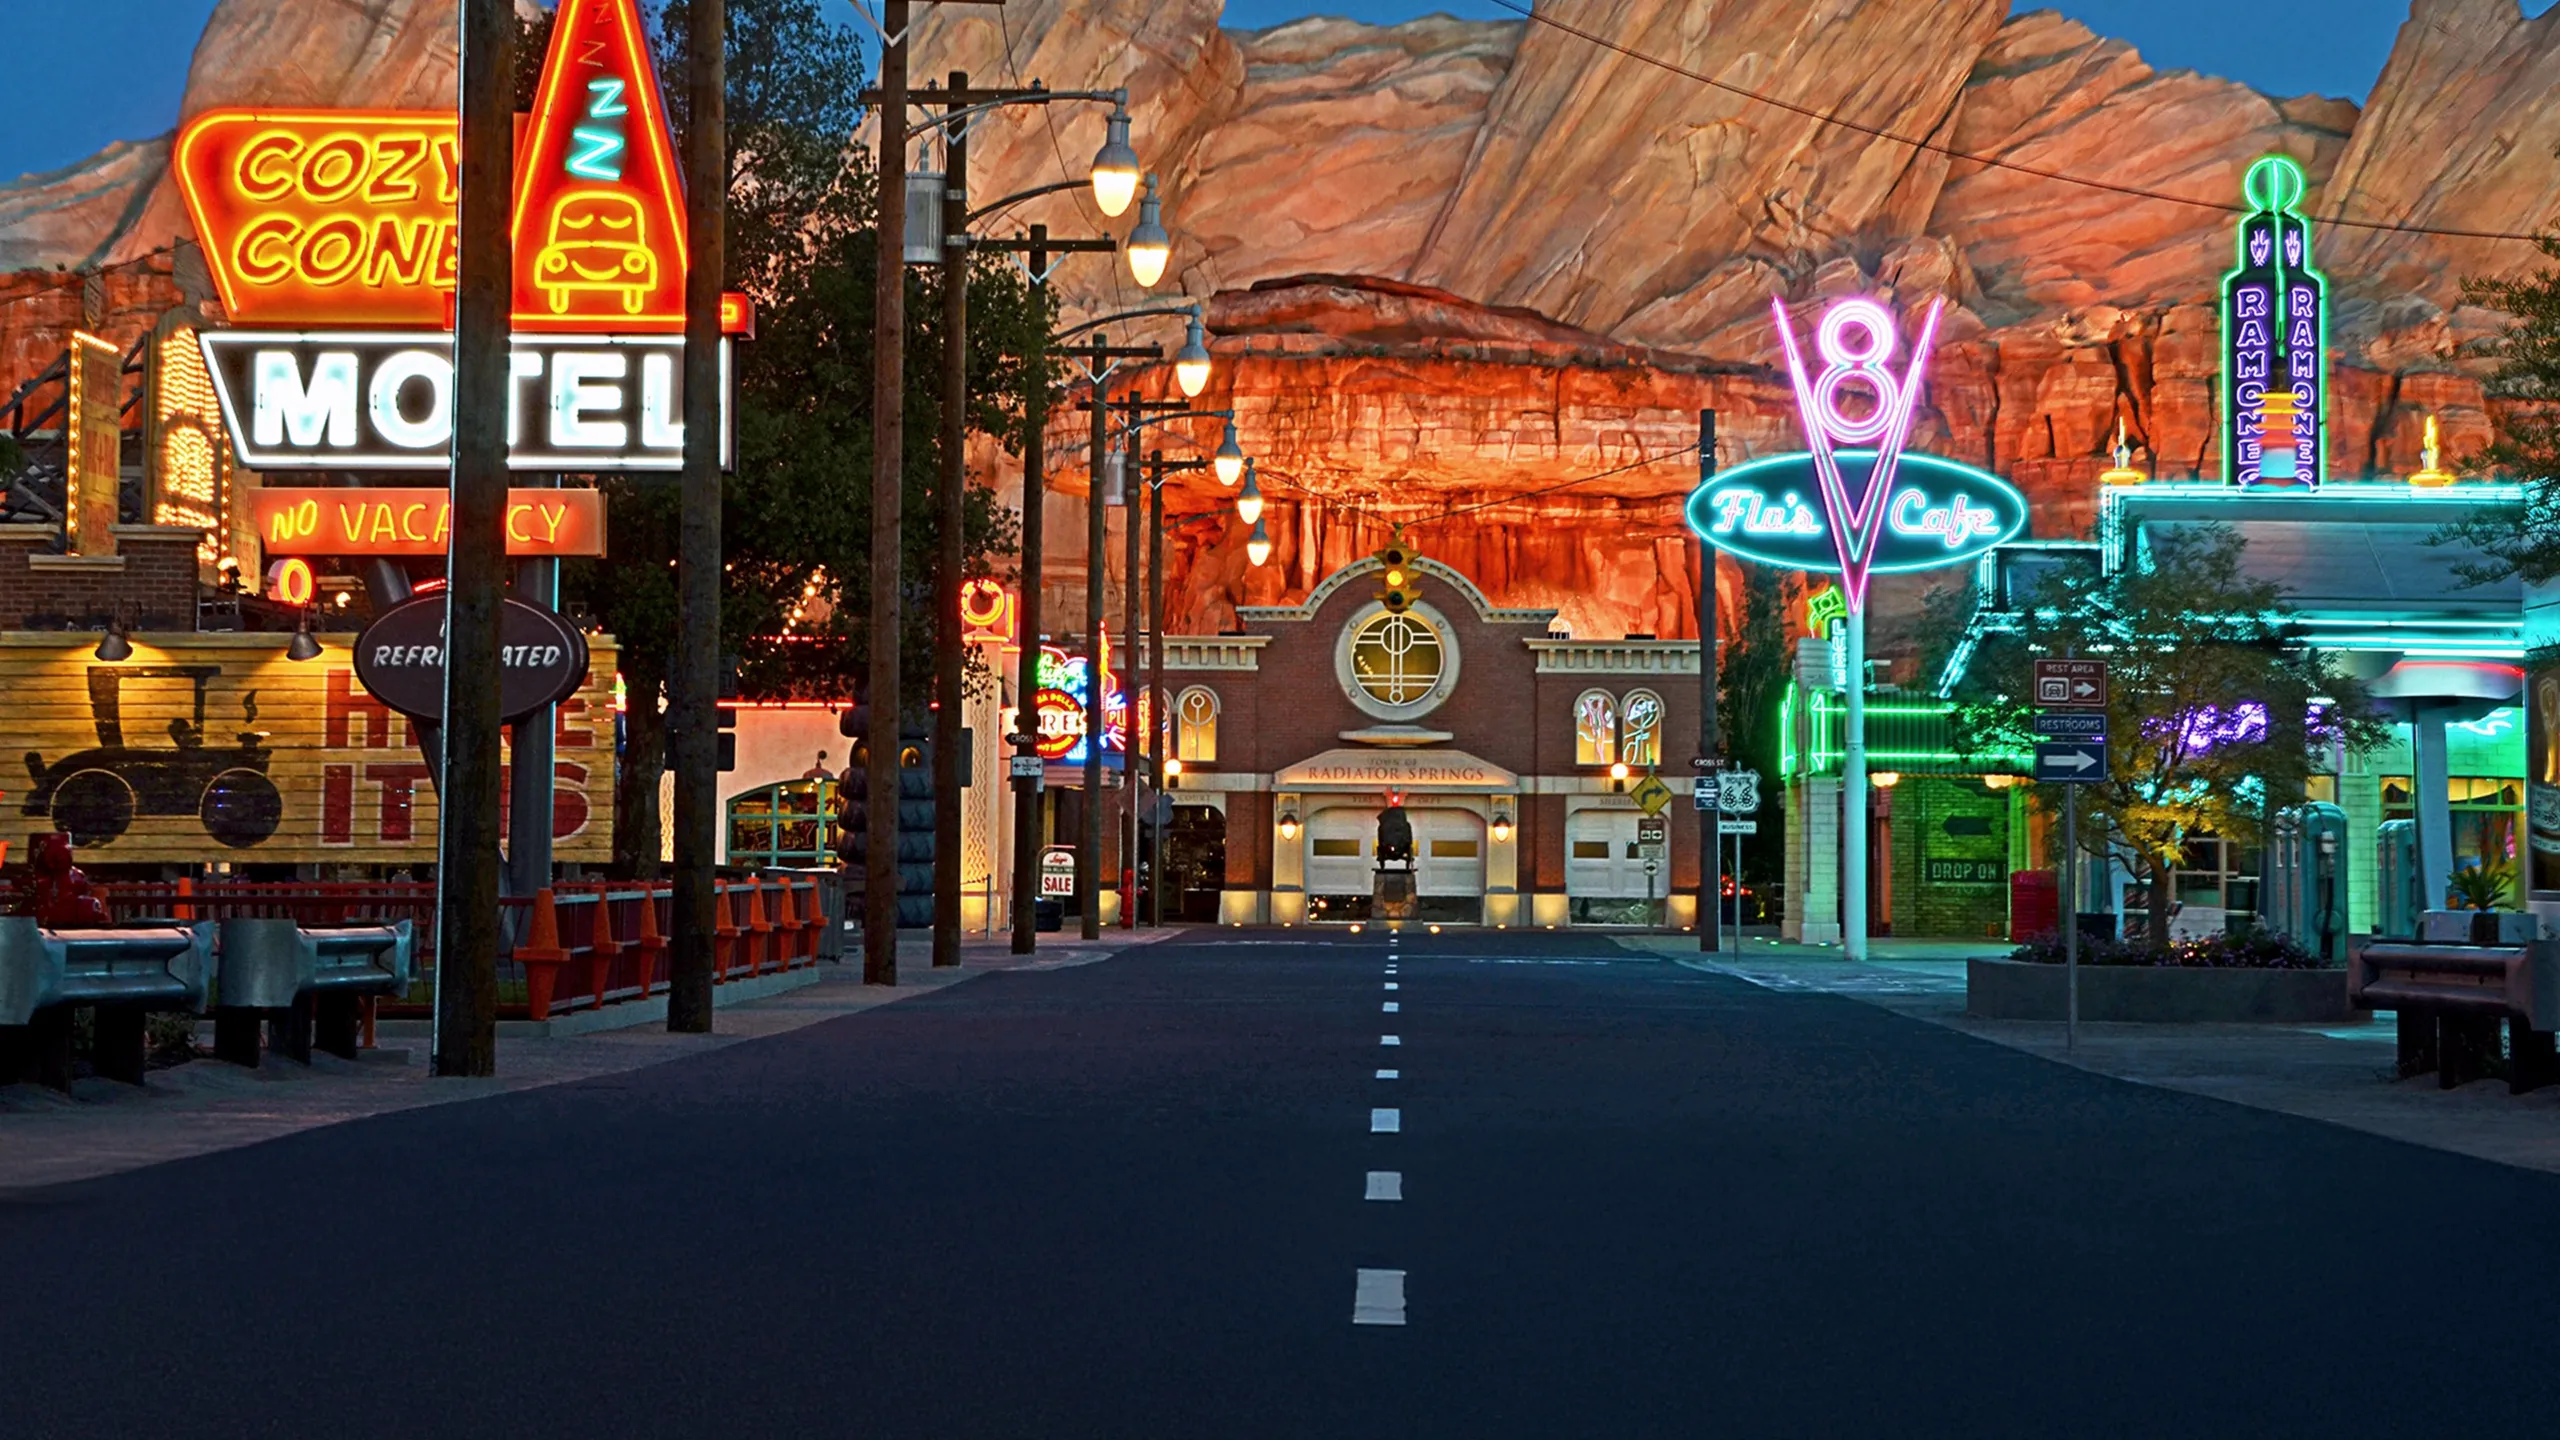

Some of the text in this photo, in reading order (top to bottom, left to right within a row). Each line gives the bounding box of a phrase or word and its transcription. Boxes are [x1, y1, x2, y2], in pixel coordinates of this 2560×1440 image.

[235, 130, 459, 203] COZY
[233, 212, 457, 287] CONE
[271, 498, 567, 543] NO VACACY
[1711, 489, 1822, 534] Flo's
[373, 646, 561, 668] REFRIATED
[2046, 664, 2095, 673] REST AREA
[324, 668, 596, 750] HE
[2040, 719, 2101, 730] RESTROOMS
[1010, 733, 1034, 744] CROSS
[1369, 757, 1417, 766] TOWN OF
[1694, 758, 1725, 767] CROSS ST
[1308, 766, 1485, 781] RADIATOR SPRINGS
[319, 761, 432, 847] IT
[1722, 786, 1754, 808] 66
[1721, 823, 1754, 831] BUSINESS
[1932, 862, 1973, 880] DROP
[1044, 876, 1072, 892] SALE
